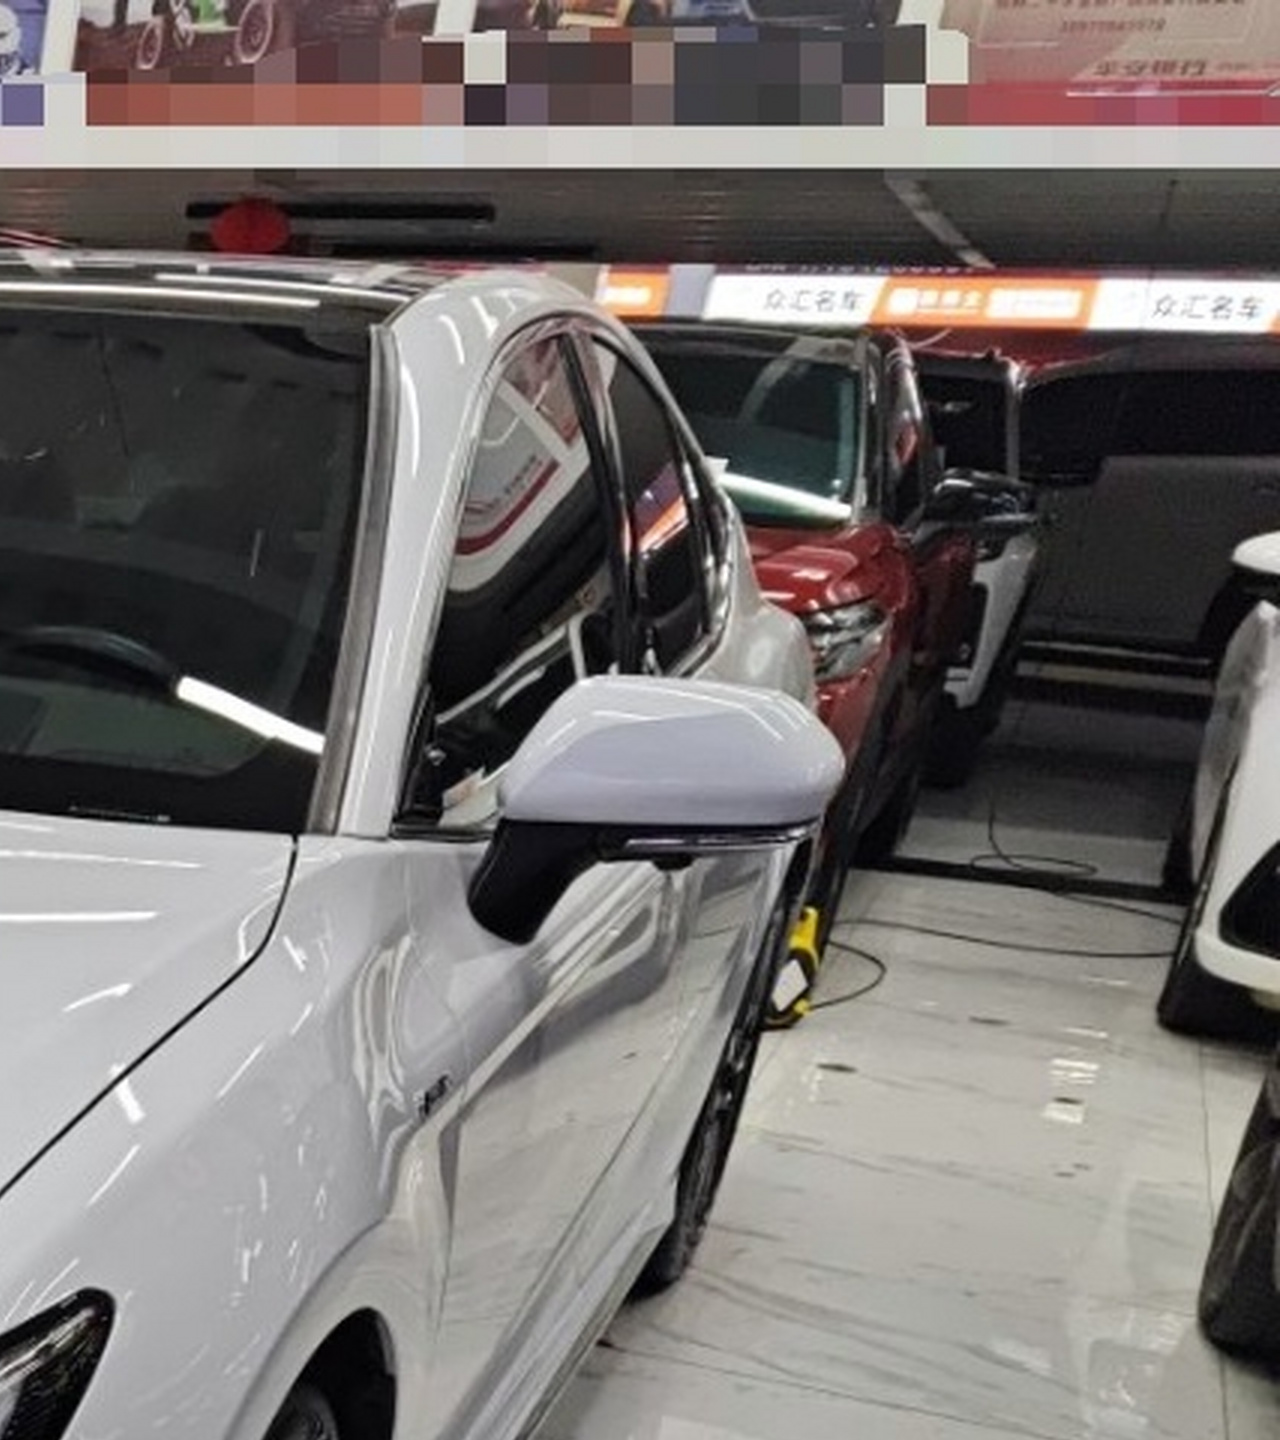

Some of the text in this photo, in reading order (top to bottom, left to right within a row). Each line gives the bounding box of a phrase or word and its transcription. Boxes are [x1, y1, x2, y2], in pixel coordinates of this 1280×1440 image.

[763, 288, 866, 312] 众汇名车
[1151, 294, 1264, 320] 众汇名车
